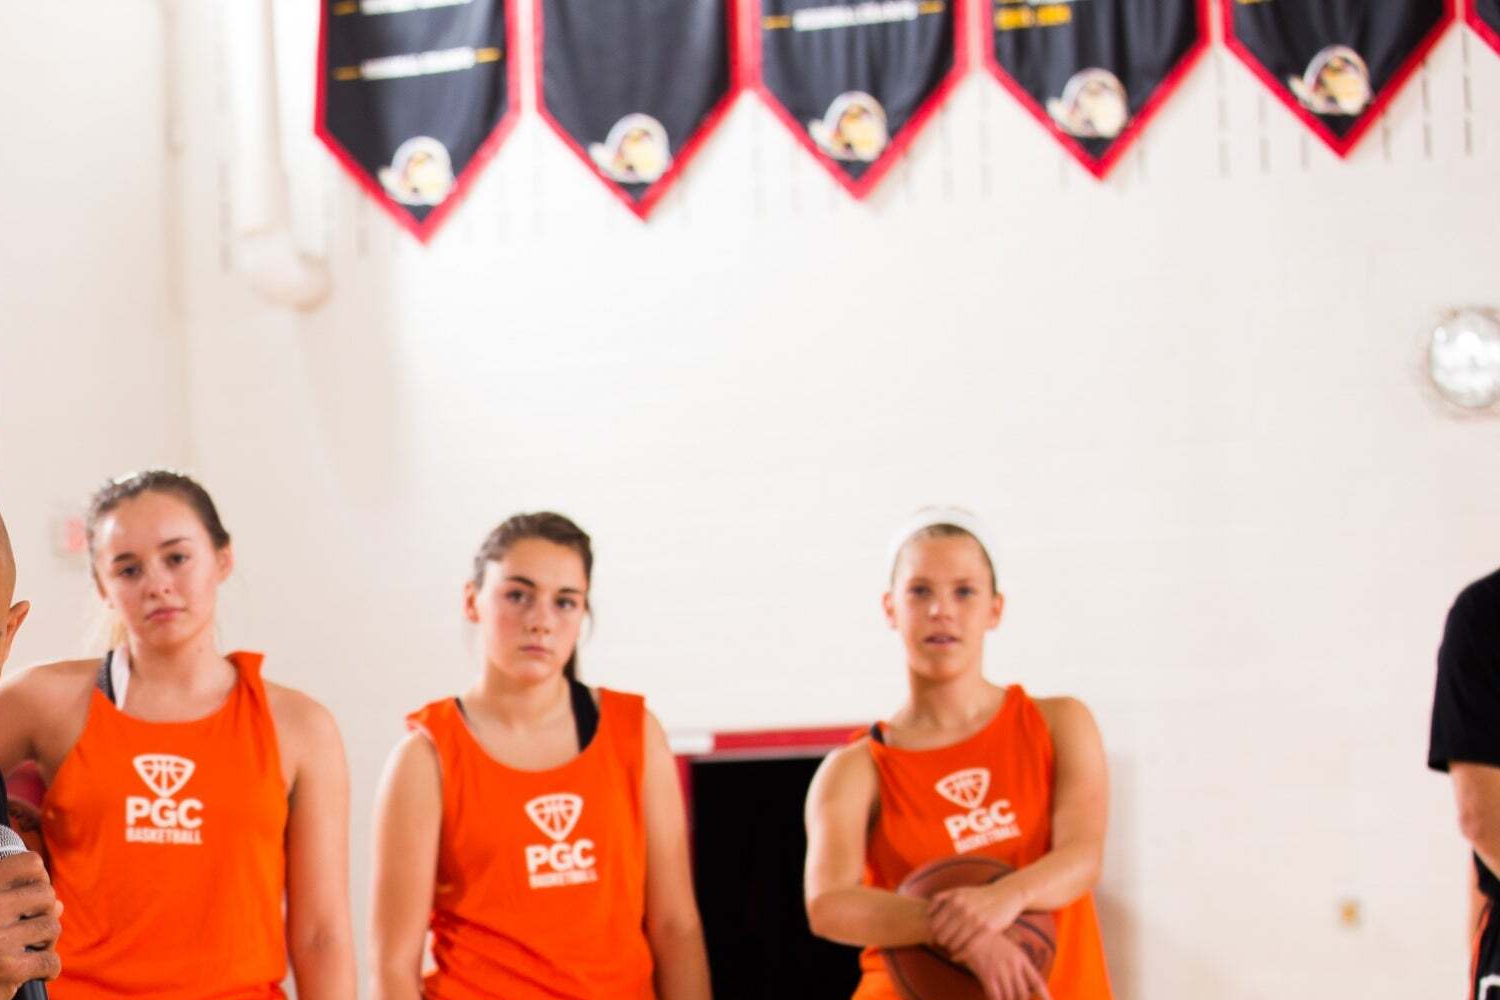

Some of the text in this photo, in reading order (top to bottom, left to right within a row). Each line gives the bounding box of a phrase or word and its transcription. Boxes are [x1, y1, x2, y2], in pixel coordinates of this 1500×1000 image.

[125, 796, 204, 829] PGC
[944, 799, 1016, 841] PGC
[525, 839, 595, 874] PGC
